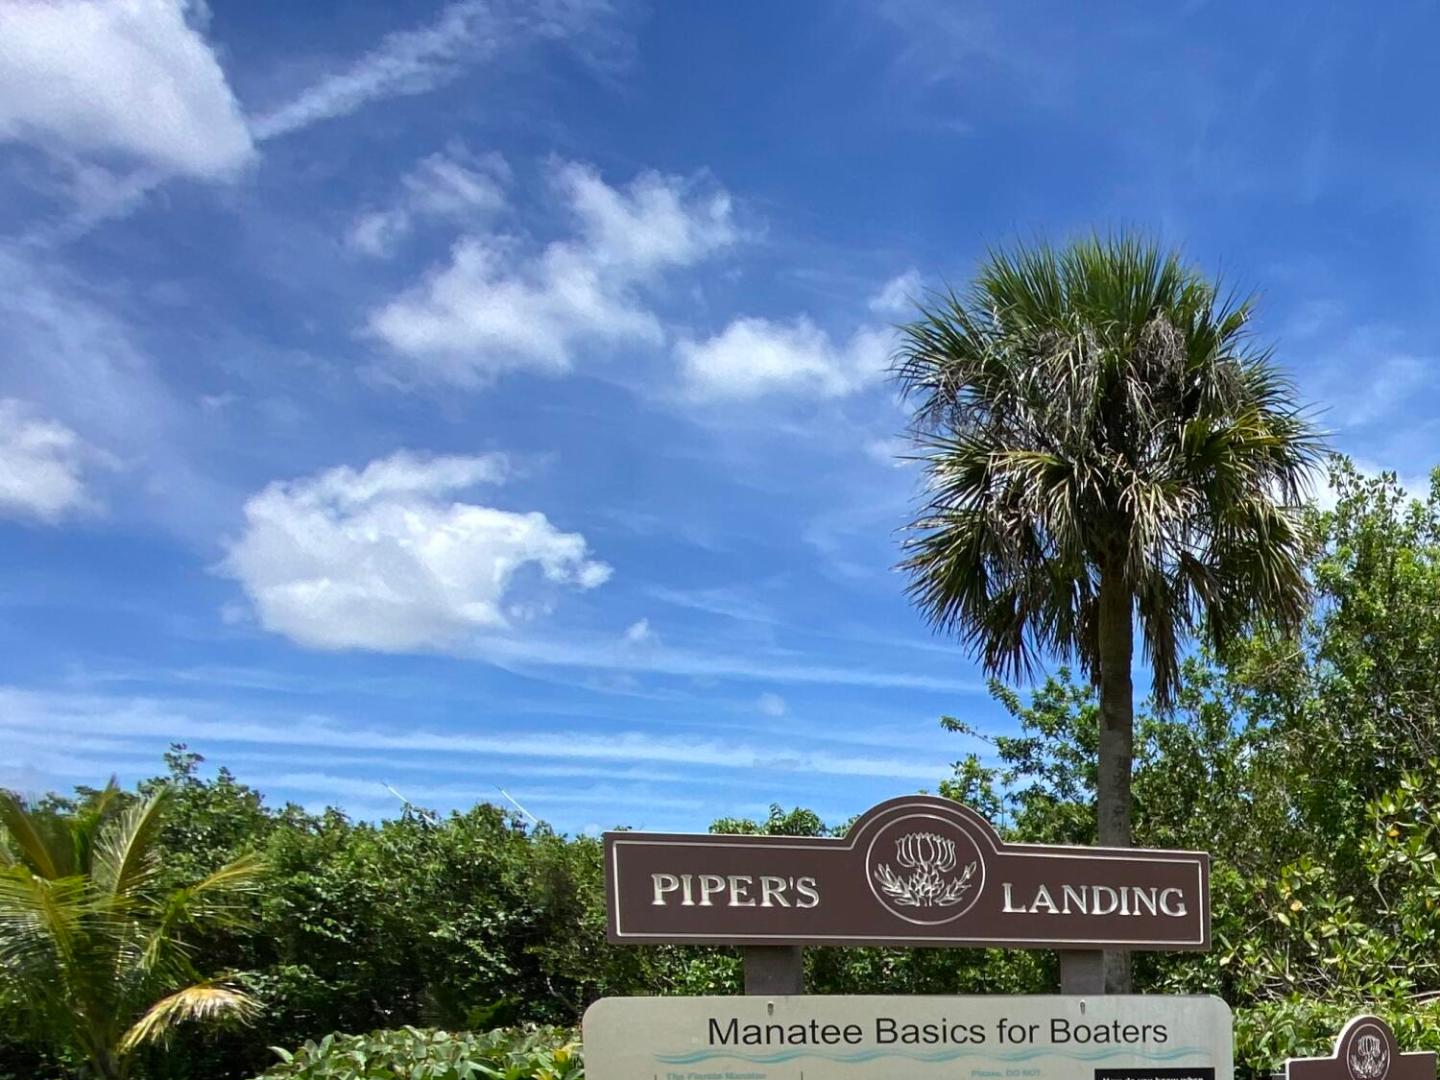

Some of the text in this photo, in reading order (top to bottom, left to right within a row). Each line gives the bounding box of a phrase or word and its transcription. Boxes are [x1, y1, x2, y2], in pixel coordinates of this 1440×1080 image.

[651, 873, 1188, 917] PIPER'S LANDING
[708, 1017, 1168, 1045] Manatee Basics for Boaters
